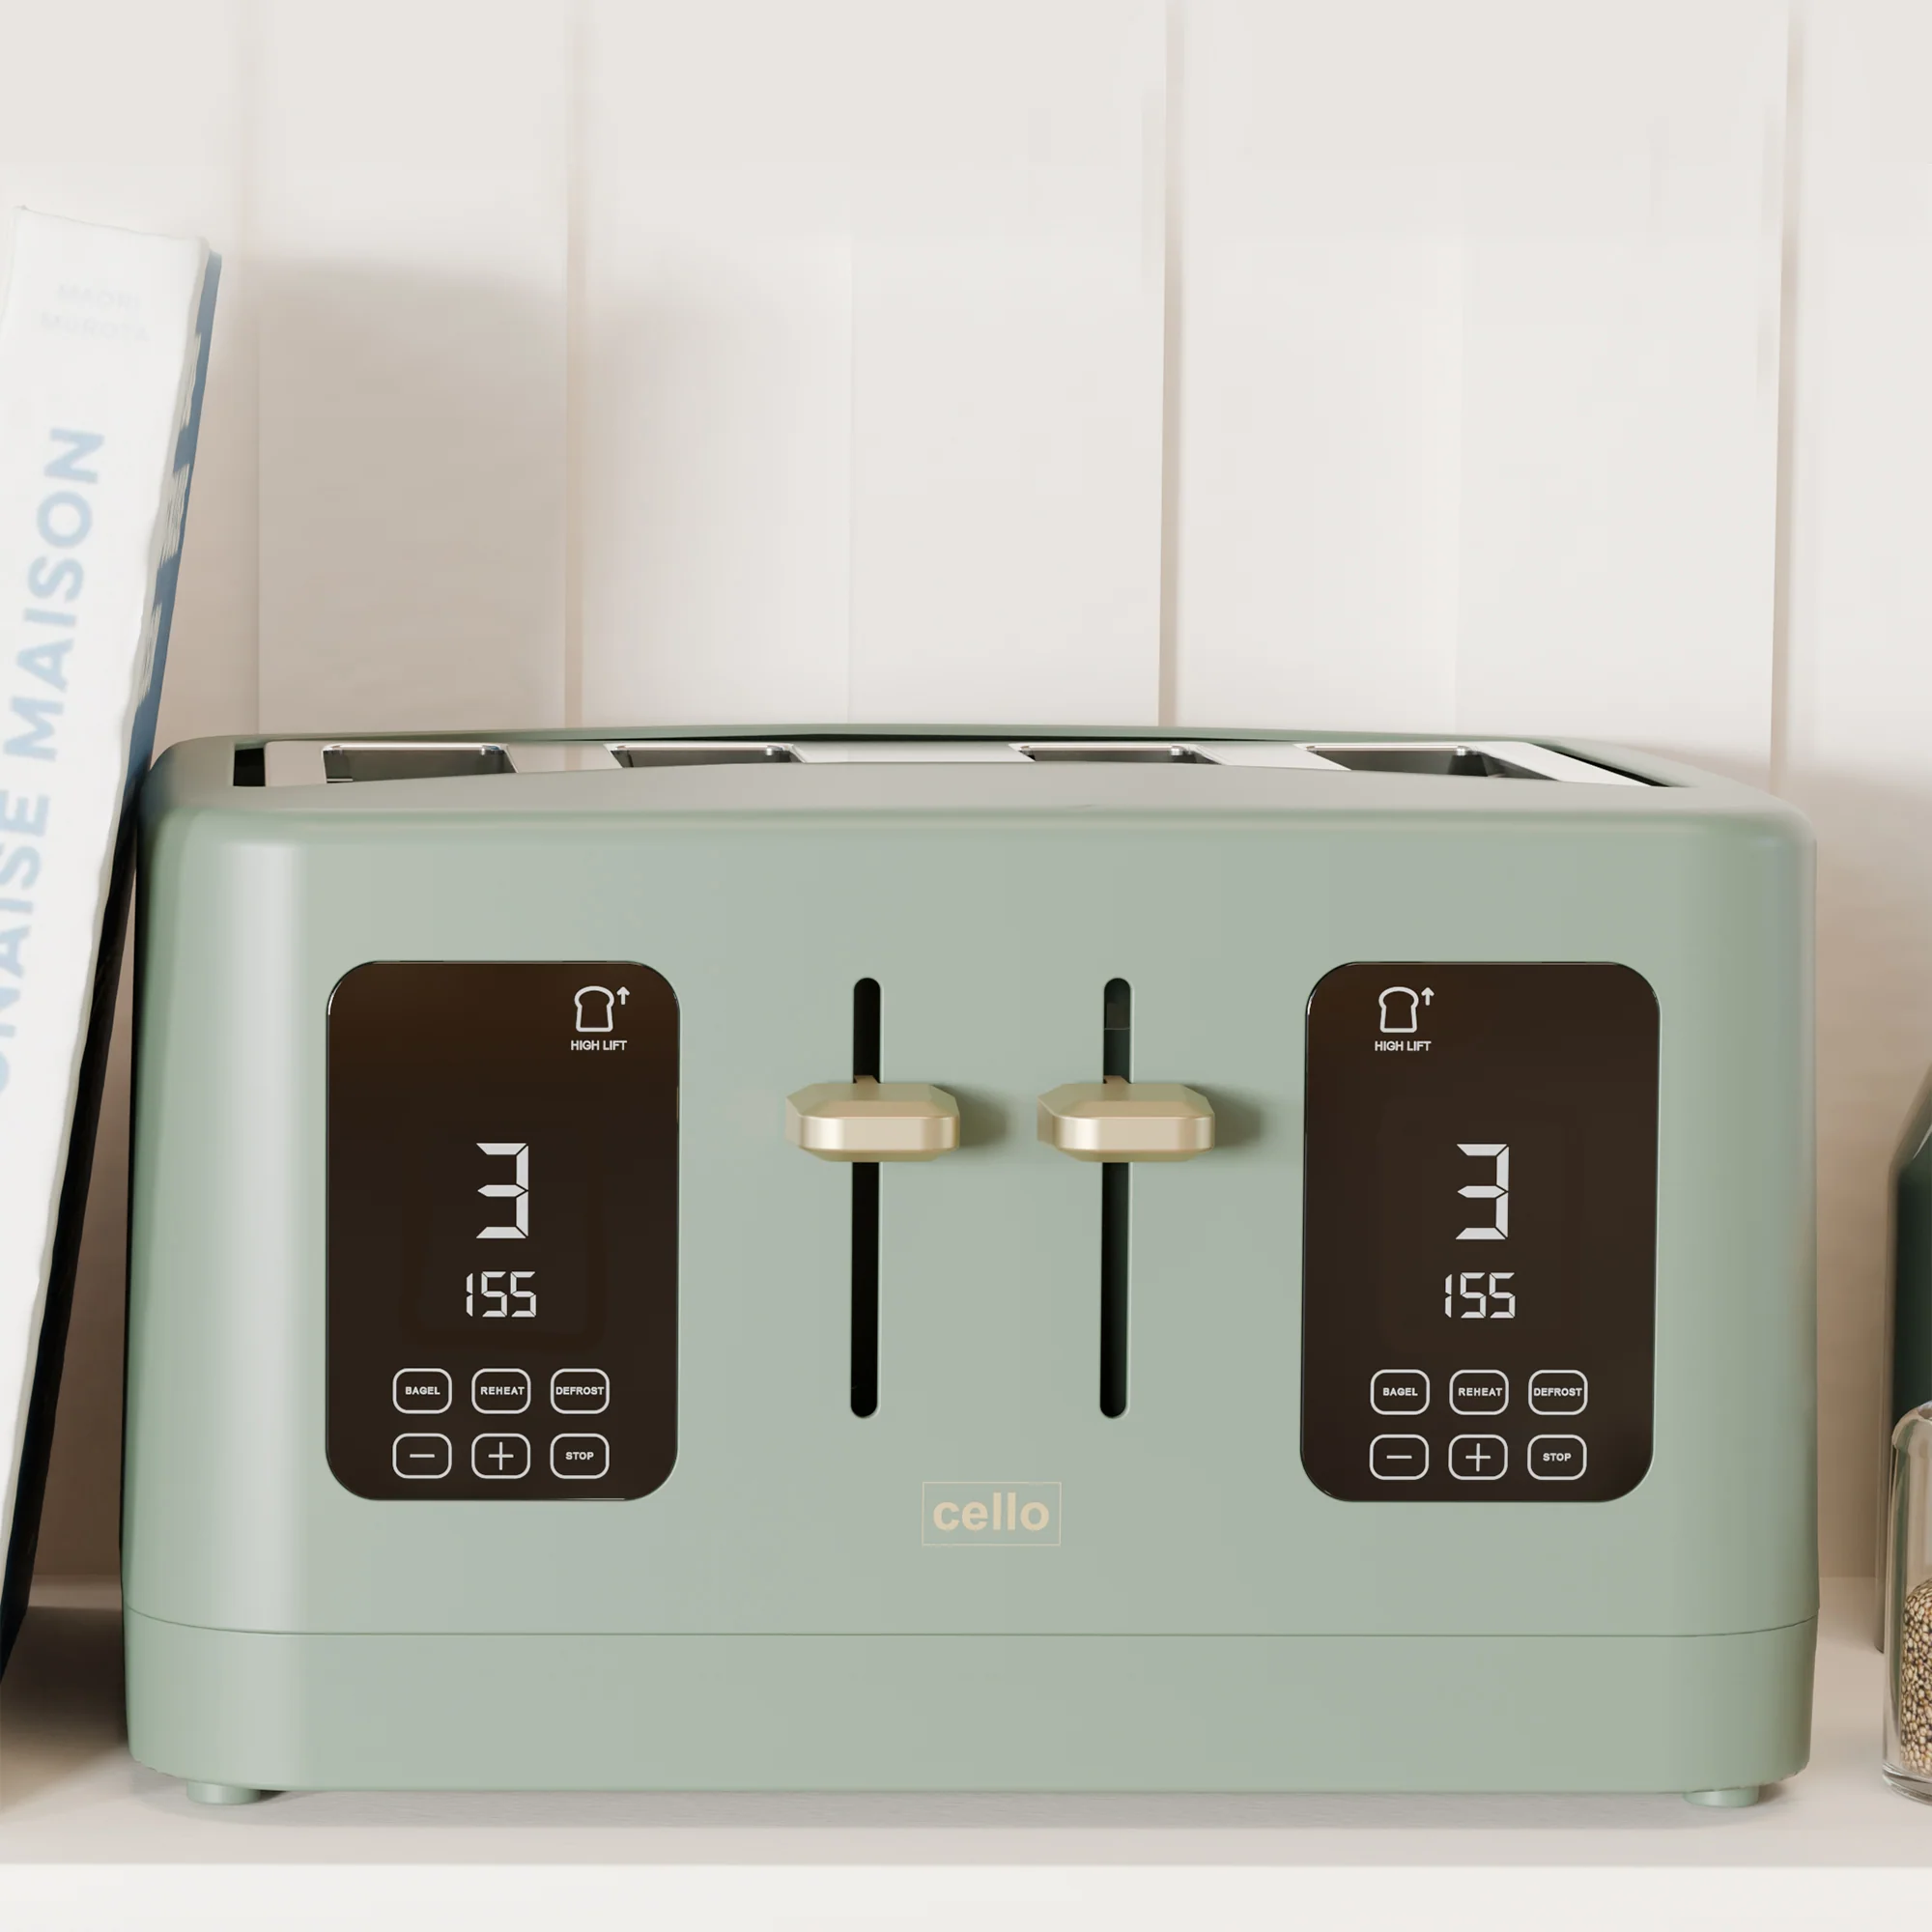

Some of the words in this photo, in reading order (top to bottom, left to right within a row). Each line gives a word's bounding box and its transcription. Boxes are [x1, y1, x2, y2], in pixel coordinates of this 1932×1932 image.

[3, 427, 105, 762] MAISON
[0, 788, 50, 1093] AISE
[570, 1039, 600, 1051] HIGH
[602, 1039, 628, 1051] LIFT
[1374, 1040, 1404, 1052] HIGH
[1406, 1040, 1432, 1052] LIFT
[475, 1142, 529, 1239] 3
[1455, 1143, 1510, 1240] 3
[466, 1270, 537, 1318] 155
[1444, 1271, 1516, 1319] 155
[405, 1385, 440, 1396] BAGEL
[480, 1385, 526, 1396] REHEAT
[555, 1385, 605, 1396] DEFROST
[1382, 1386, 1418, 1397] BAGEL
[1458, 1386, 1503, 1397] REHEAT
[1533, 1386, 1582, 1397] DEFROST
[565, 1451, 594, 1461] STOP
[1542, 1452, 1572, 1463] STOP
[932, 1492, 1050, 1531] cello
